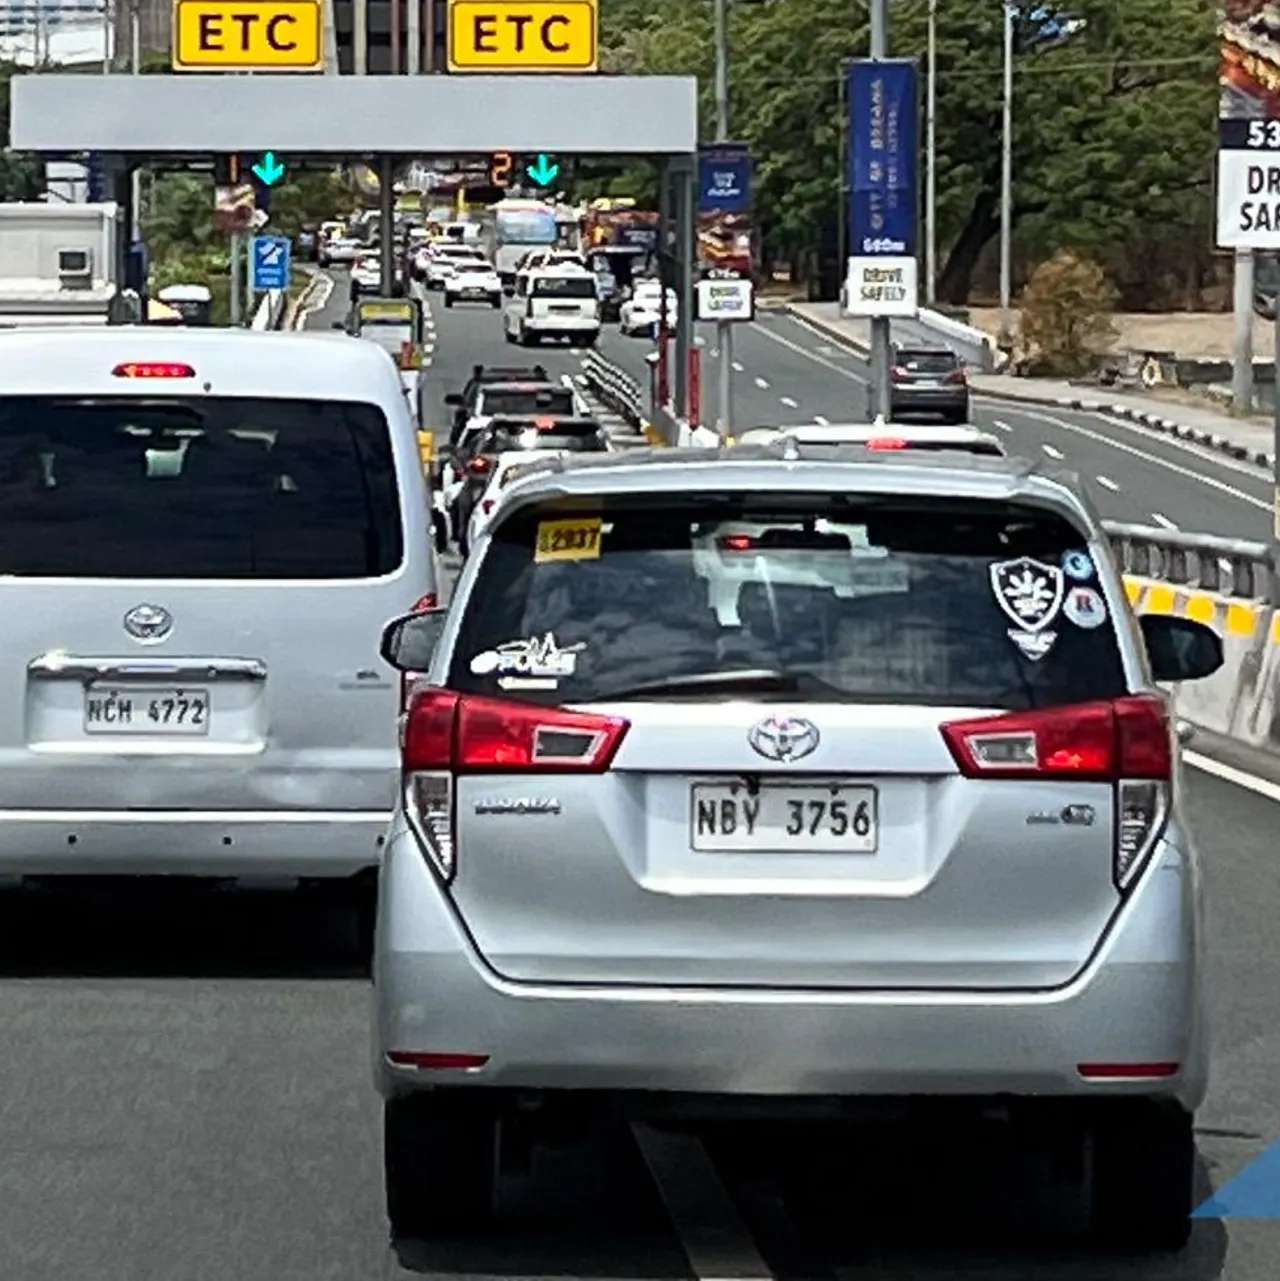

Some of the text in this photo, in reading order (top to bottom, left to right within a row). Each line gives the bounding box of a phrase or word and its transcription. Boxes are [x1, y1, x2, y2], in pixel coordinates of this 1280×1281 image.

[199, 13, 298, 52] ETC
[473, 14, 572, 53] ETC
[491, 151, 512, 187] 2
[698, 799, 870, 837] NBY 3756
